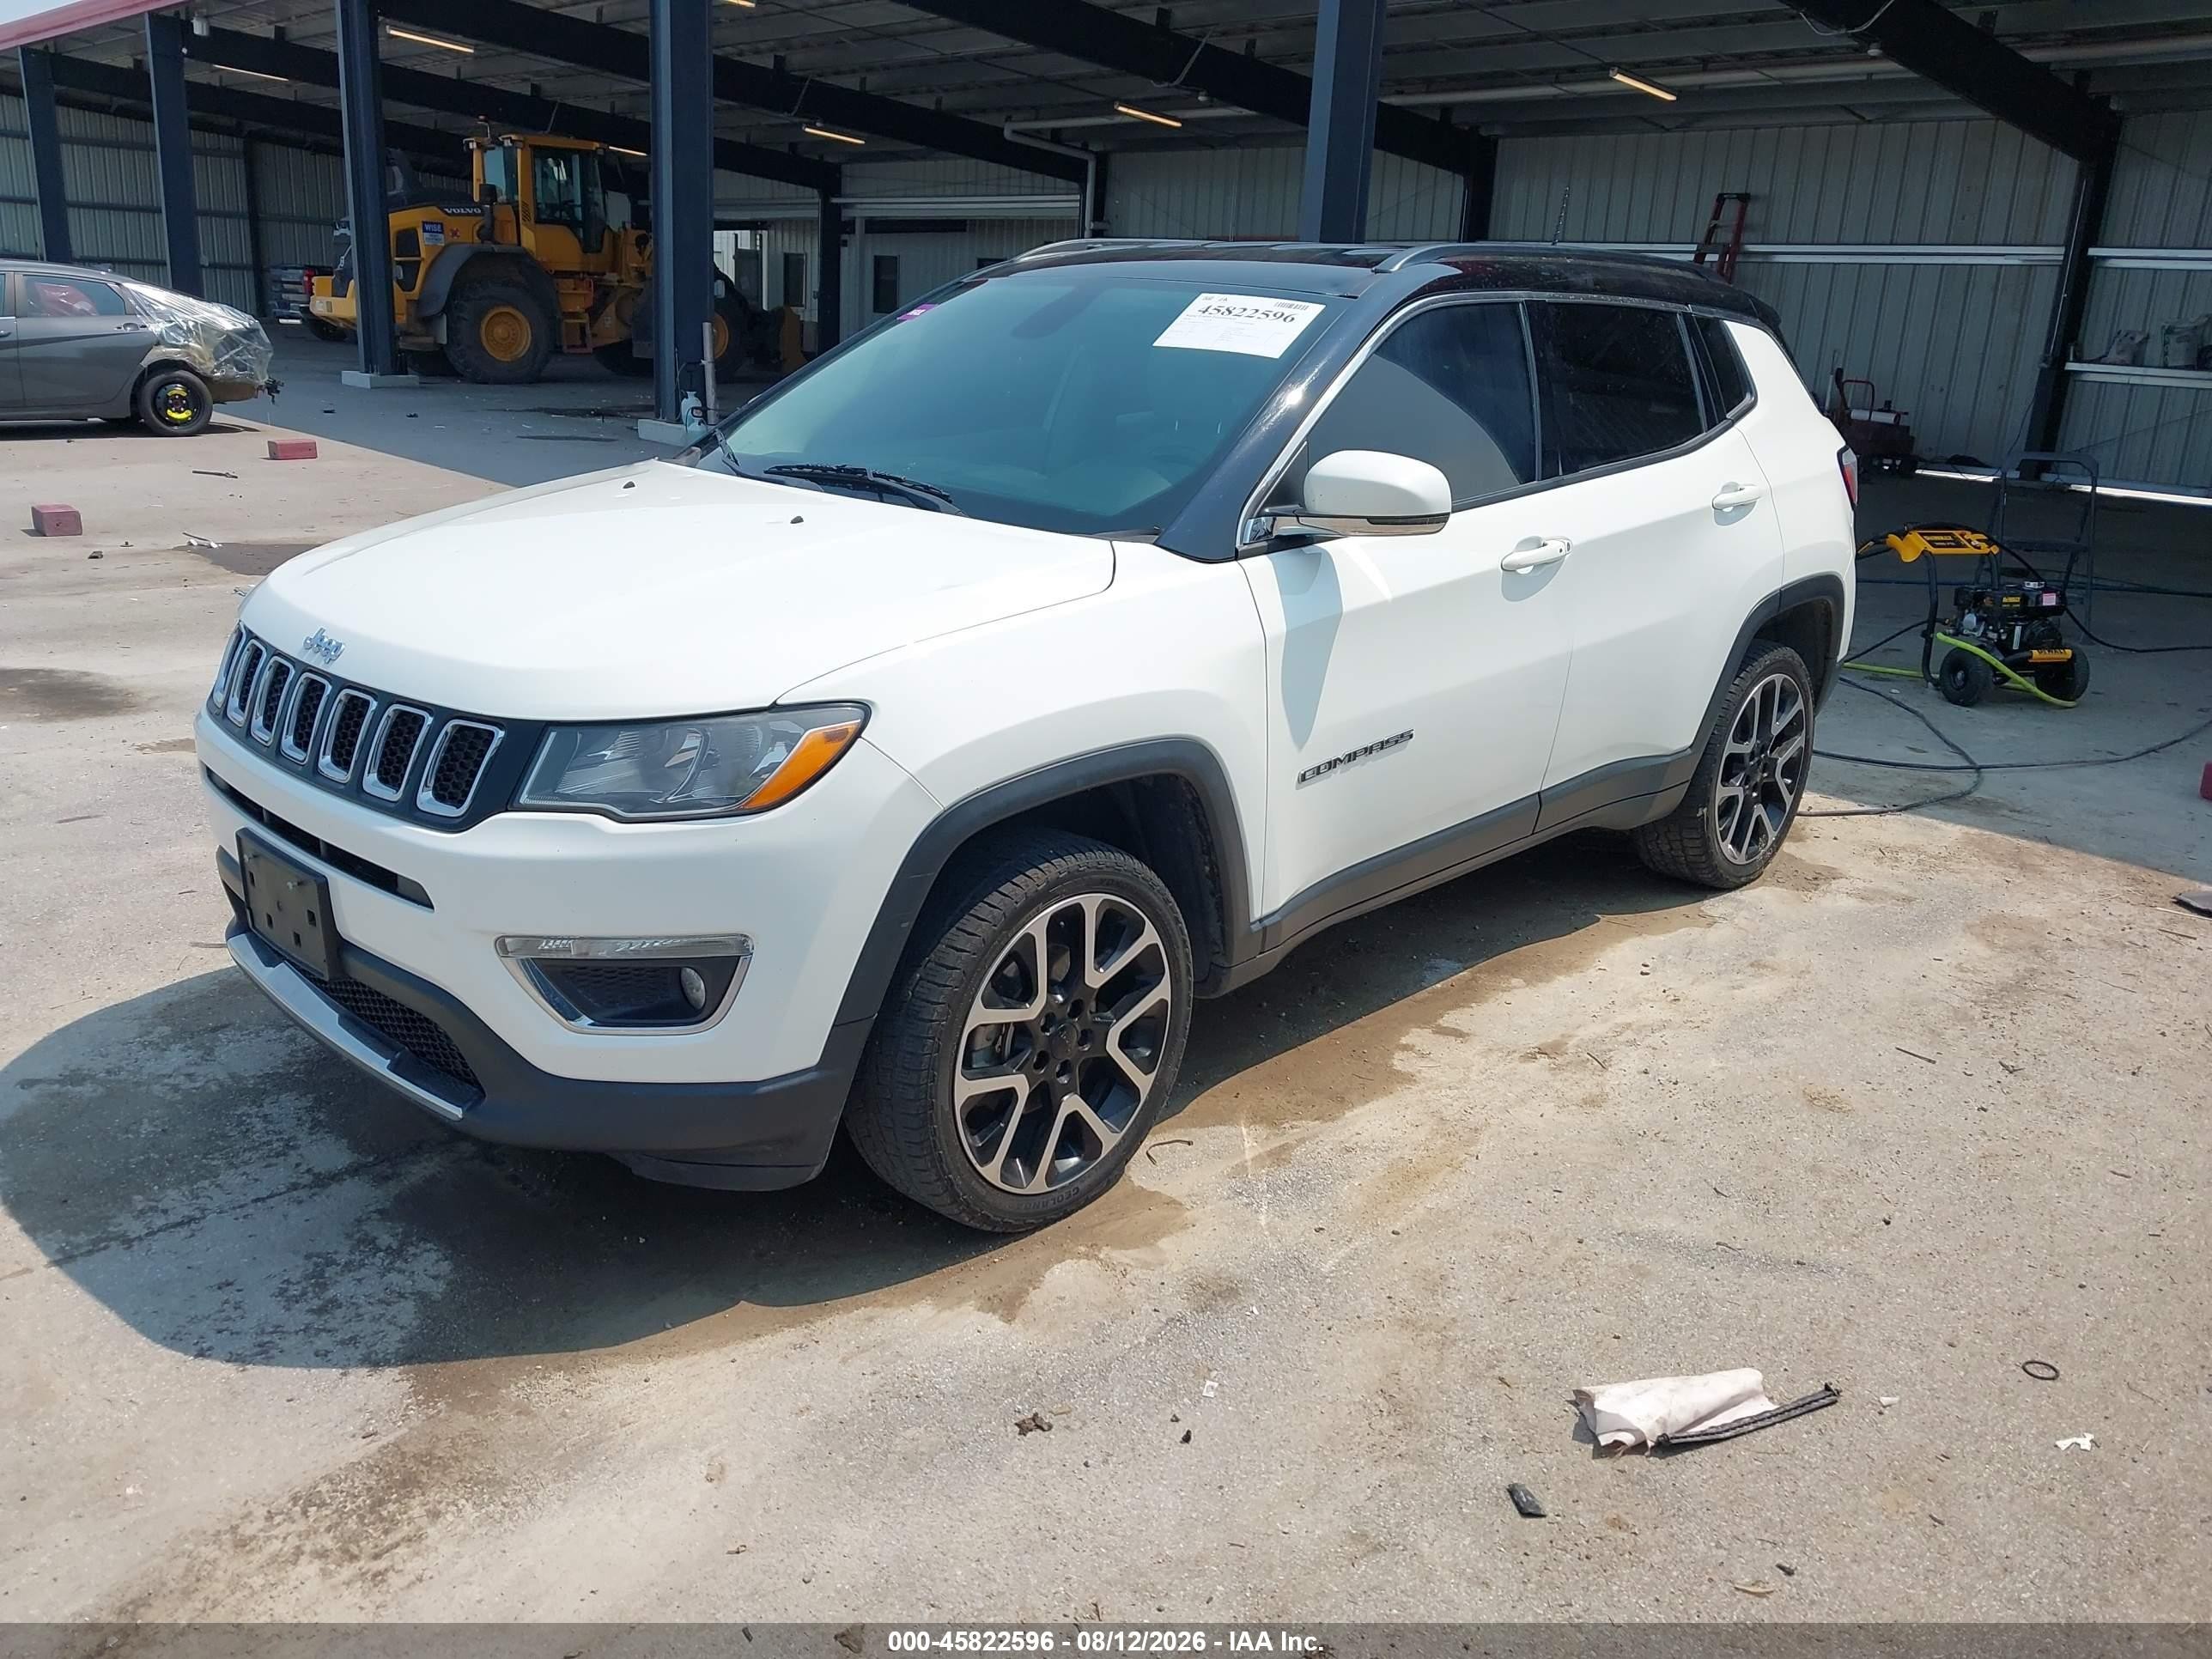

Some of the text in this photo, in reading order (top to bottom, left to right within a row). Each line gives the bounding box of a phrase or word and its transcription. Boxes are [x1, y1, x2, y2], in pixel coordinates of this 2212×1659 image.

[1198, 305, 1298, 323] 45822596
[303, 627, 345, 664] Jeep
[1297, 728, 1414, 784] COMPASS
